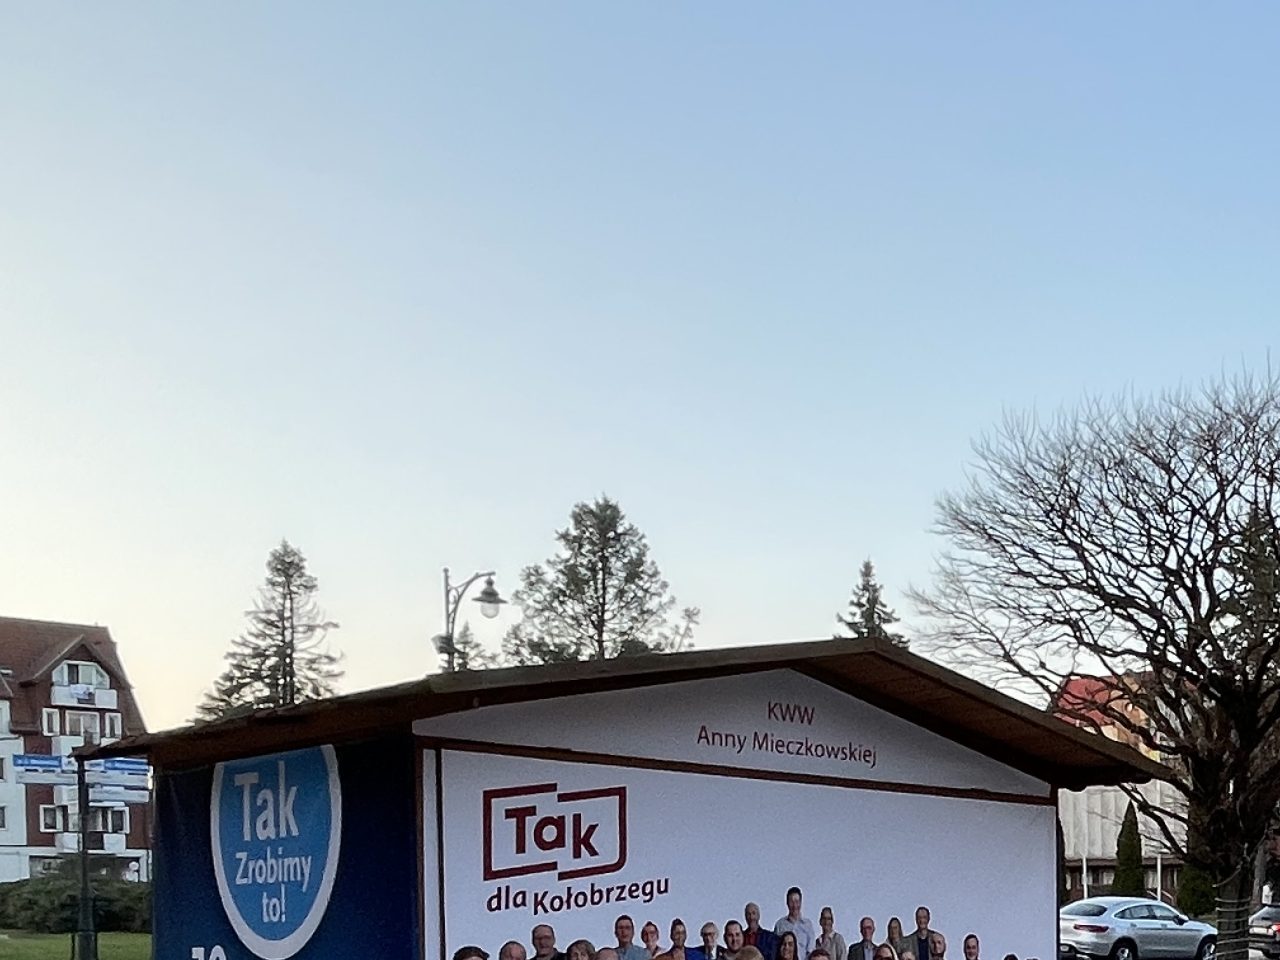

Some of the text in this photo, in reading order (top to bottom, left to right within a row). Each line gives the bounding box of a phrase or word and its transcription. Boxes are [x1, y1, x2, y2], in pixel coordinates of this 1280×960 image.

[767, 701, 815, 726] KWW
[697, 725, 877, 769] Anny Mieczkowskiej
[234, 761, 299, 841] Tak
[504, 805, 600, 859] Tak
[235, 847, 312, 893] Zrobimy
[262, 884, 286, 923] to!
[486, 877, 669, 915] dla Kołobrzegu
